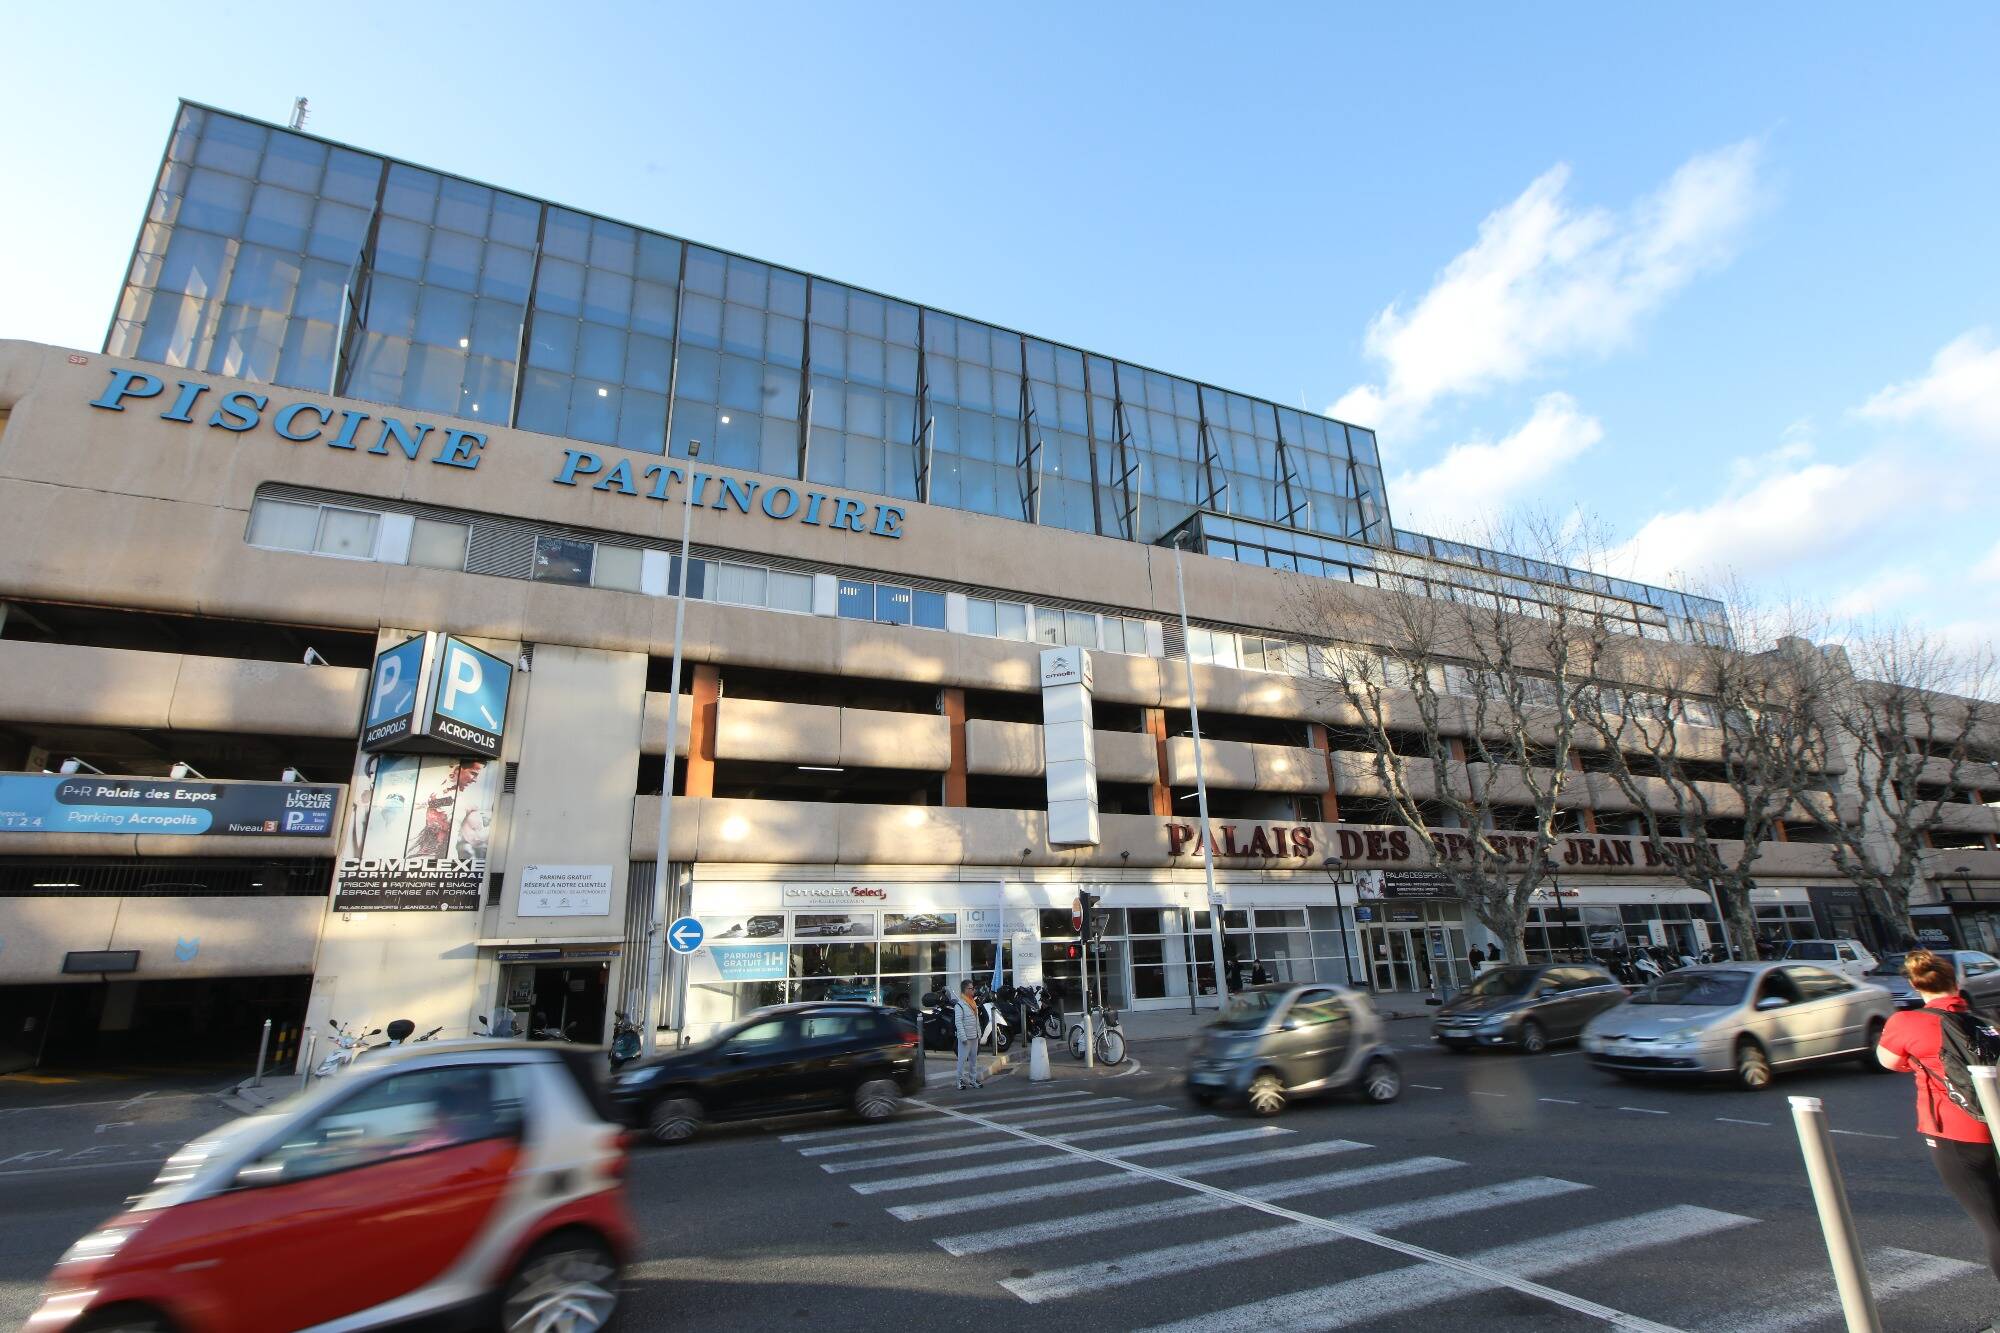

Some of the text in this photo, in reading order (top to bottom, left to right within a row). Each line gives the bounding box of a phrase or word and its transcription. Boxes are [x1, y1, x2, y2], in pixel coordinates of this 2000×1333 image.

[90, 368, 906, 539] PISCINE PATINOIRE
[444, 648, 483, 711] P
[372, 655, 402, 720] P
[366, 719, 407, 743] ACROPOLIS
[438, 721, 496, 749] ACROPOLIS
[62, 785, 217, 802] P+R Palais des Expos
[287, 789, 332, 802] LIGNES
[285, 801, 331, 809] D'AZUR
[19, 818, 28, 826] 2
[32, 818, 42, 827] 4
[68, 811, 198, 826] Parking Acropolis
[228, 821, 275, 832] Niveau 3
[1166, 823, 1315, 859] PALAIS
[1336, 829, 1410, 861] DES
[1564, 838, 1635, 866] JEAN
[340, 858, 486, 872] COMPLEXE
[338, 871, 485, 879] SPORTIF MUNICIPAL
[853, 887, 884, 897] select
[966, 911, 985, 921] ICI
[765, 951, 784, 966] 1H
